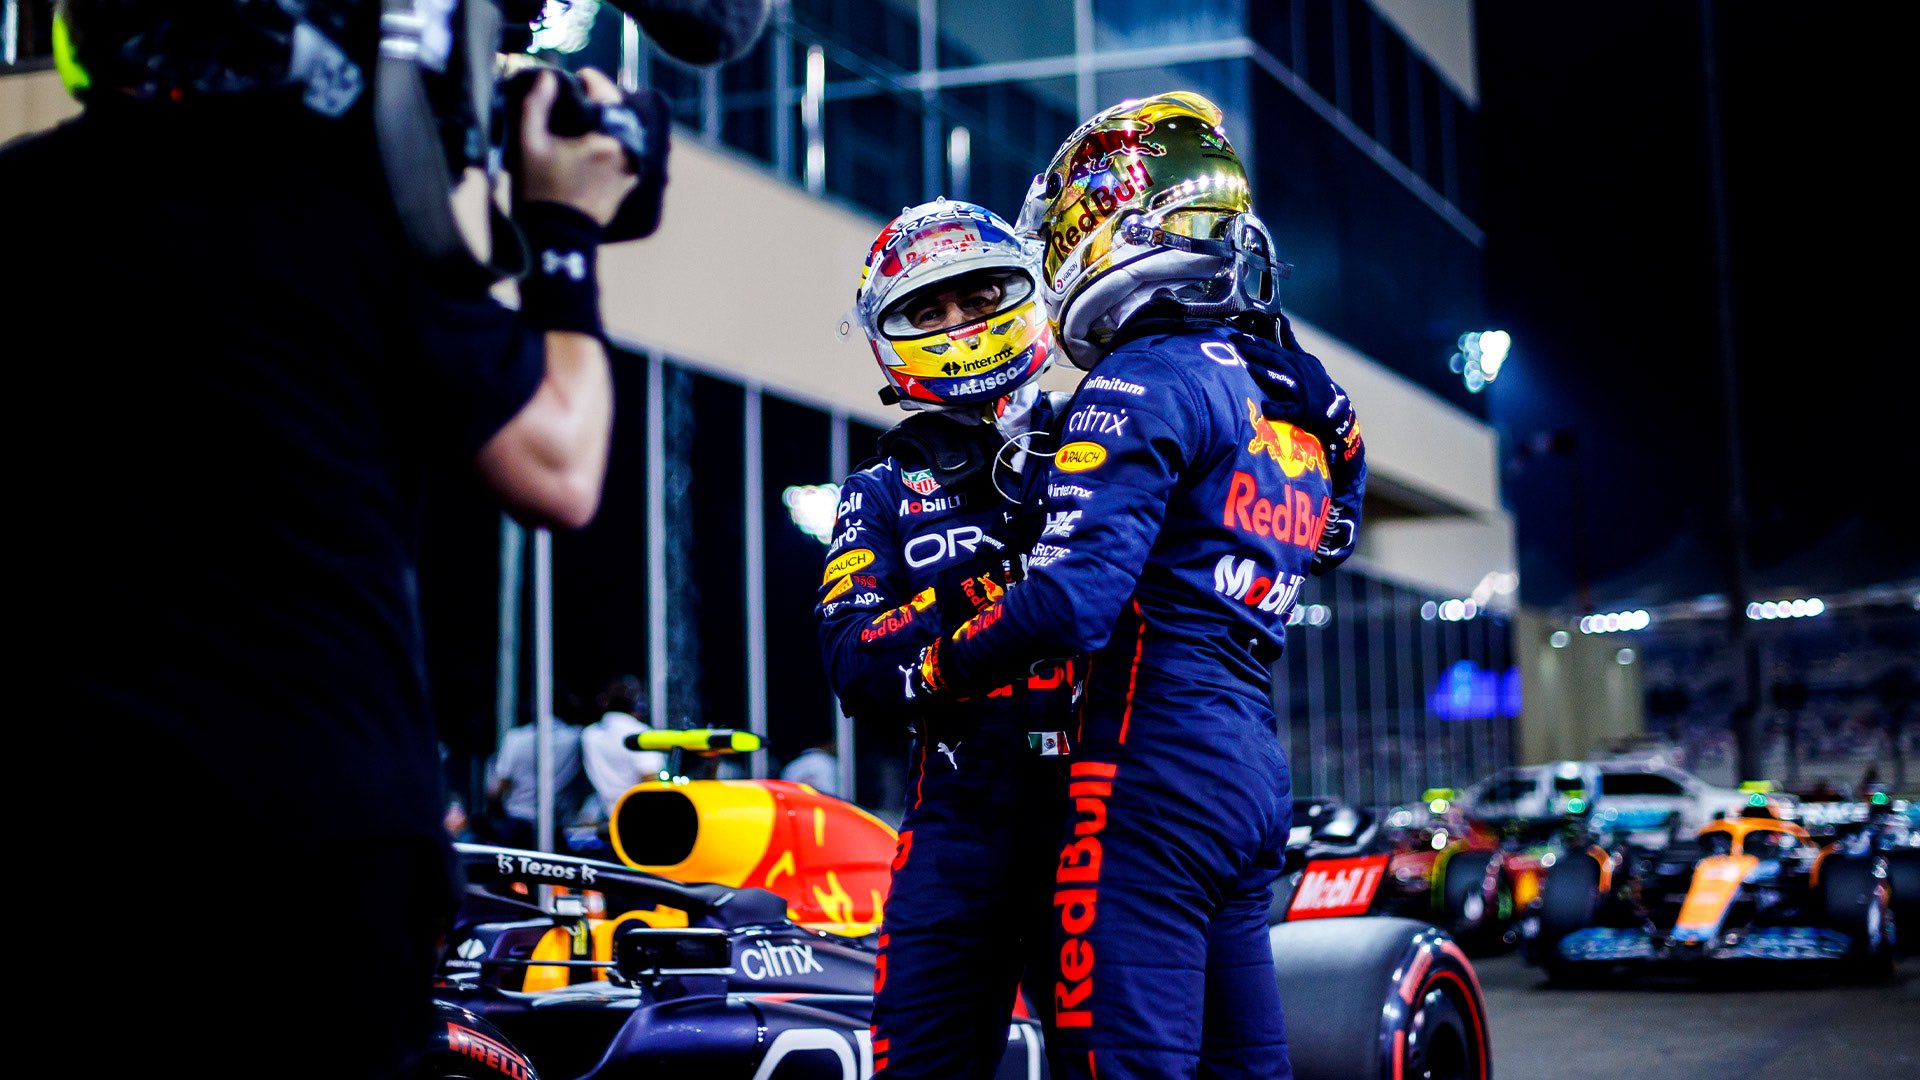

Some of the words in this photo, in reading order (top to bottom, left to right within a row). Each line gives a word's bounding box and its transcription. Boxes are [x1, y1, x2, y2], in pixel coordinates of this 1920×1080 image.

[962, 346, 1014, 372] inter.mx
[1068, 404, 1128, 436] citrix
[1066, 451, 1100, 464] RAUCH
[517, 856, 577, 880] Tezos
